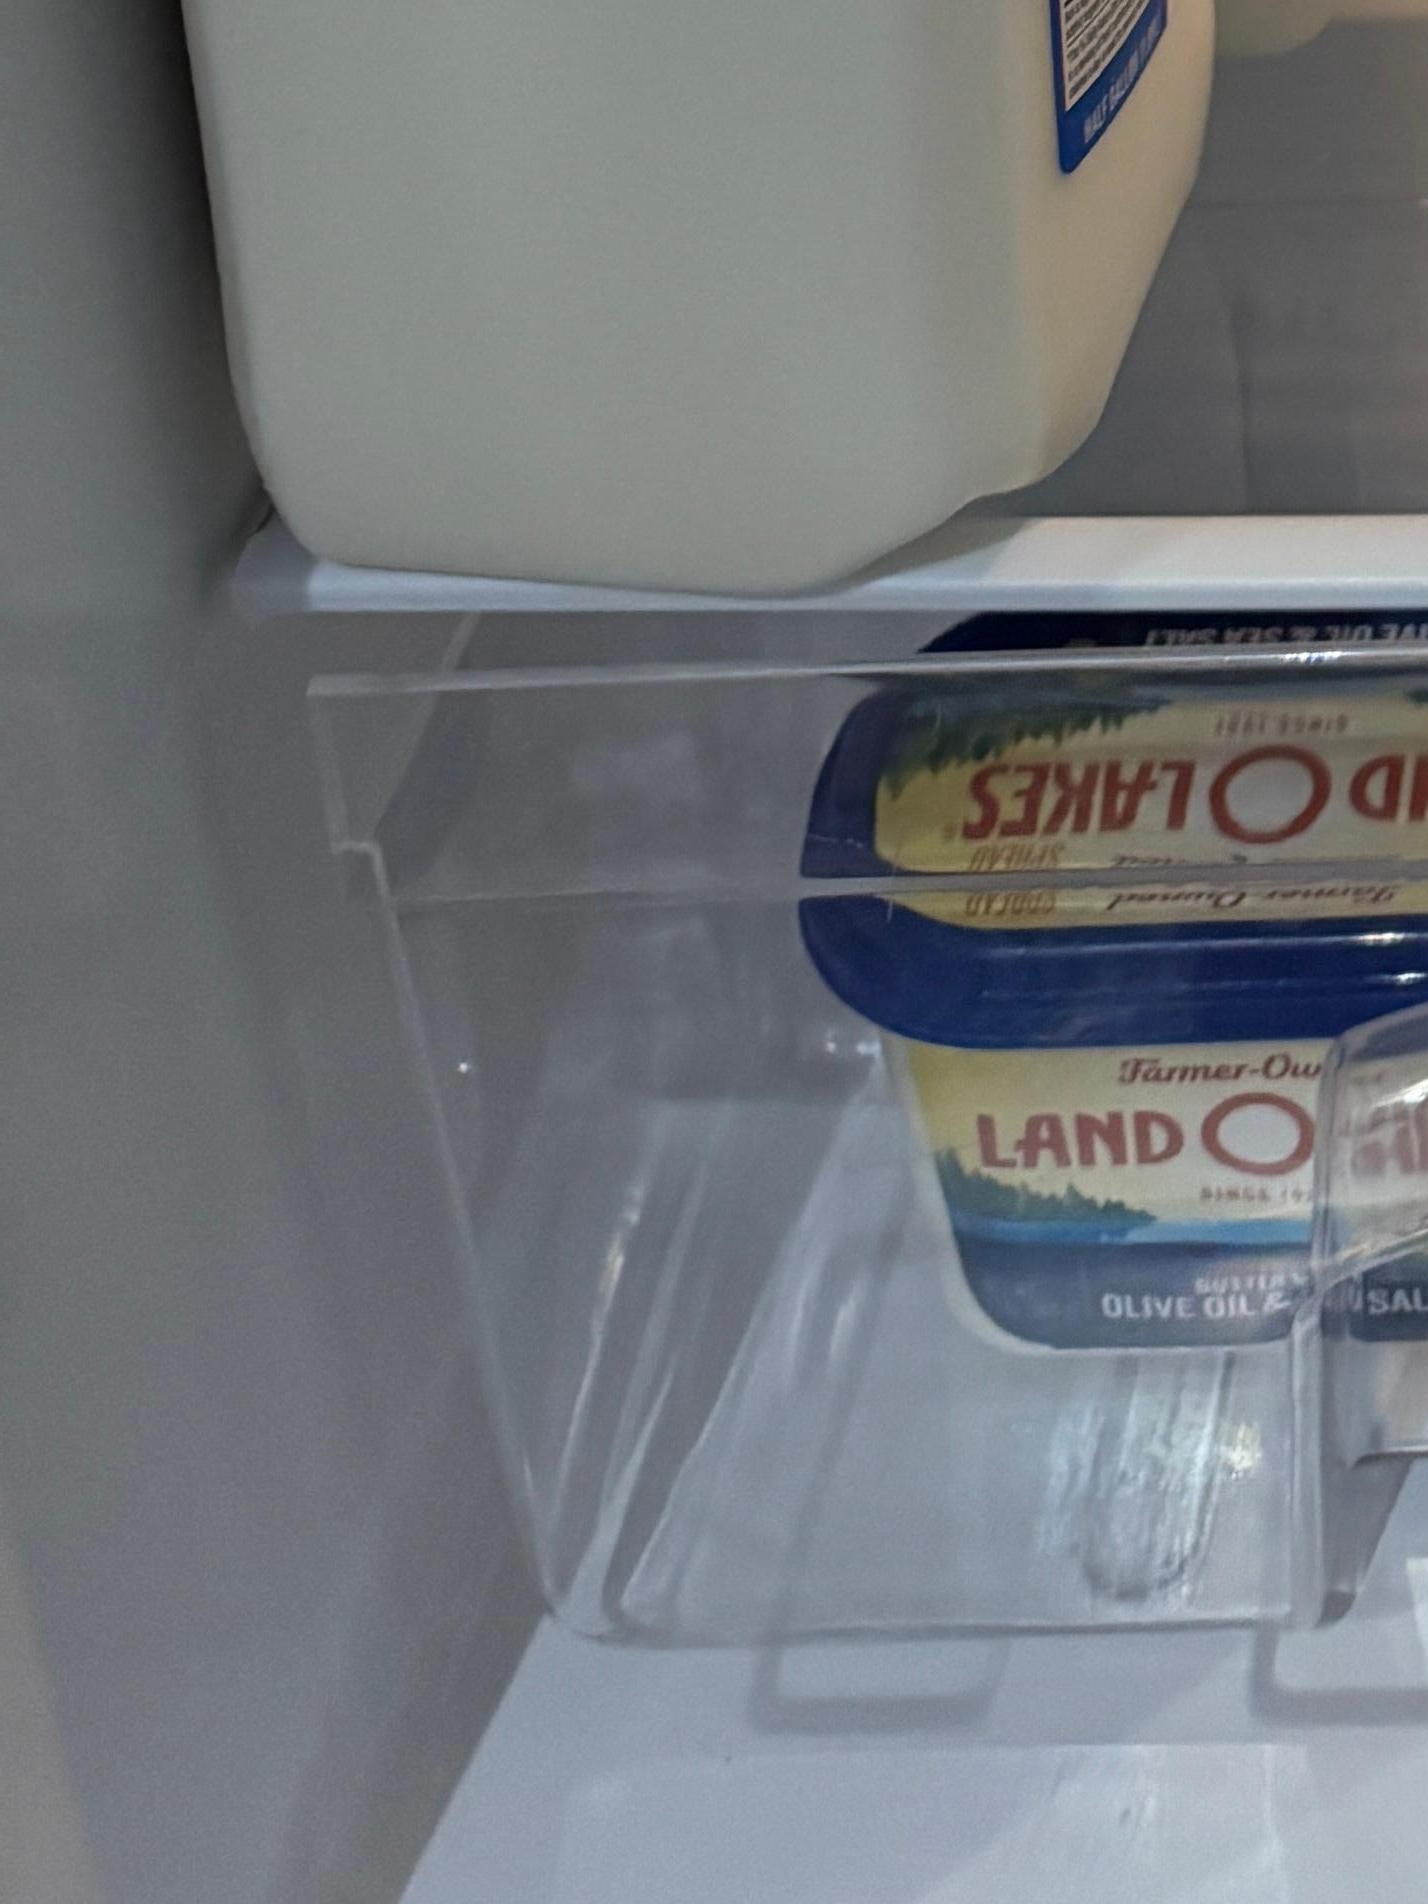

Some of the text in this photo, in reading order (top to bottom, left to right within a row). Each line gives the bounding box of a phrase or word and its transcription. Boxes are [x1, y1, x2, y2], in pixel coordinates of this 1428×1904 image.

[961, 759, 1198, 841] LAKES
[1210, 745, 1331, 843] O
[1117, 1053, 1323, 1086] Farmer-Ow
[977, 1109, 1184, 1170] LAND
[1202, 1092, 1316, 1176] O
[1101, 1292, 1197, 1320] OLIVE
[1203, 1292, 1256, 1318] OIL
